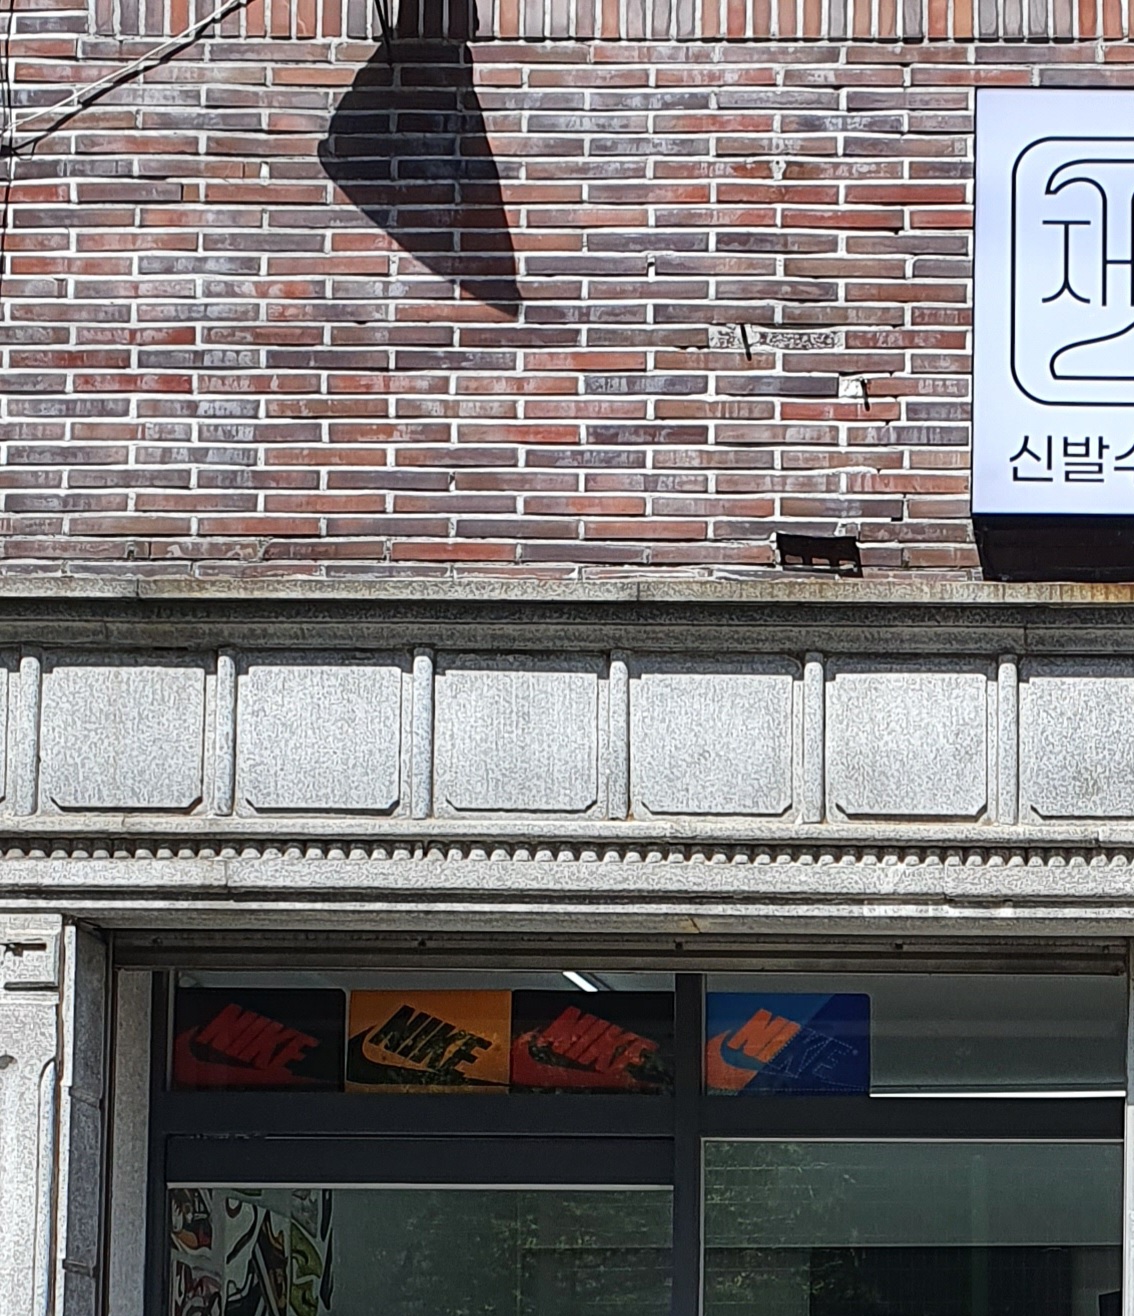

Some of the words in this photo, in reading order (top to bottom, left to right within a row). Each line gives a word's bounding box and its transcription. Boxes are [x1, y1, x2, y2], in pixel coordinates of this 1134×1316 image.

[197, 1003, 319, 1071] NIKE
[369, 1004, 494, 1077] NIKE
[539, 1005, 659, 1074] NIKE
[727, 1008, 854, 1080] NIKE
